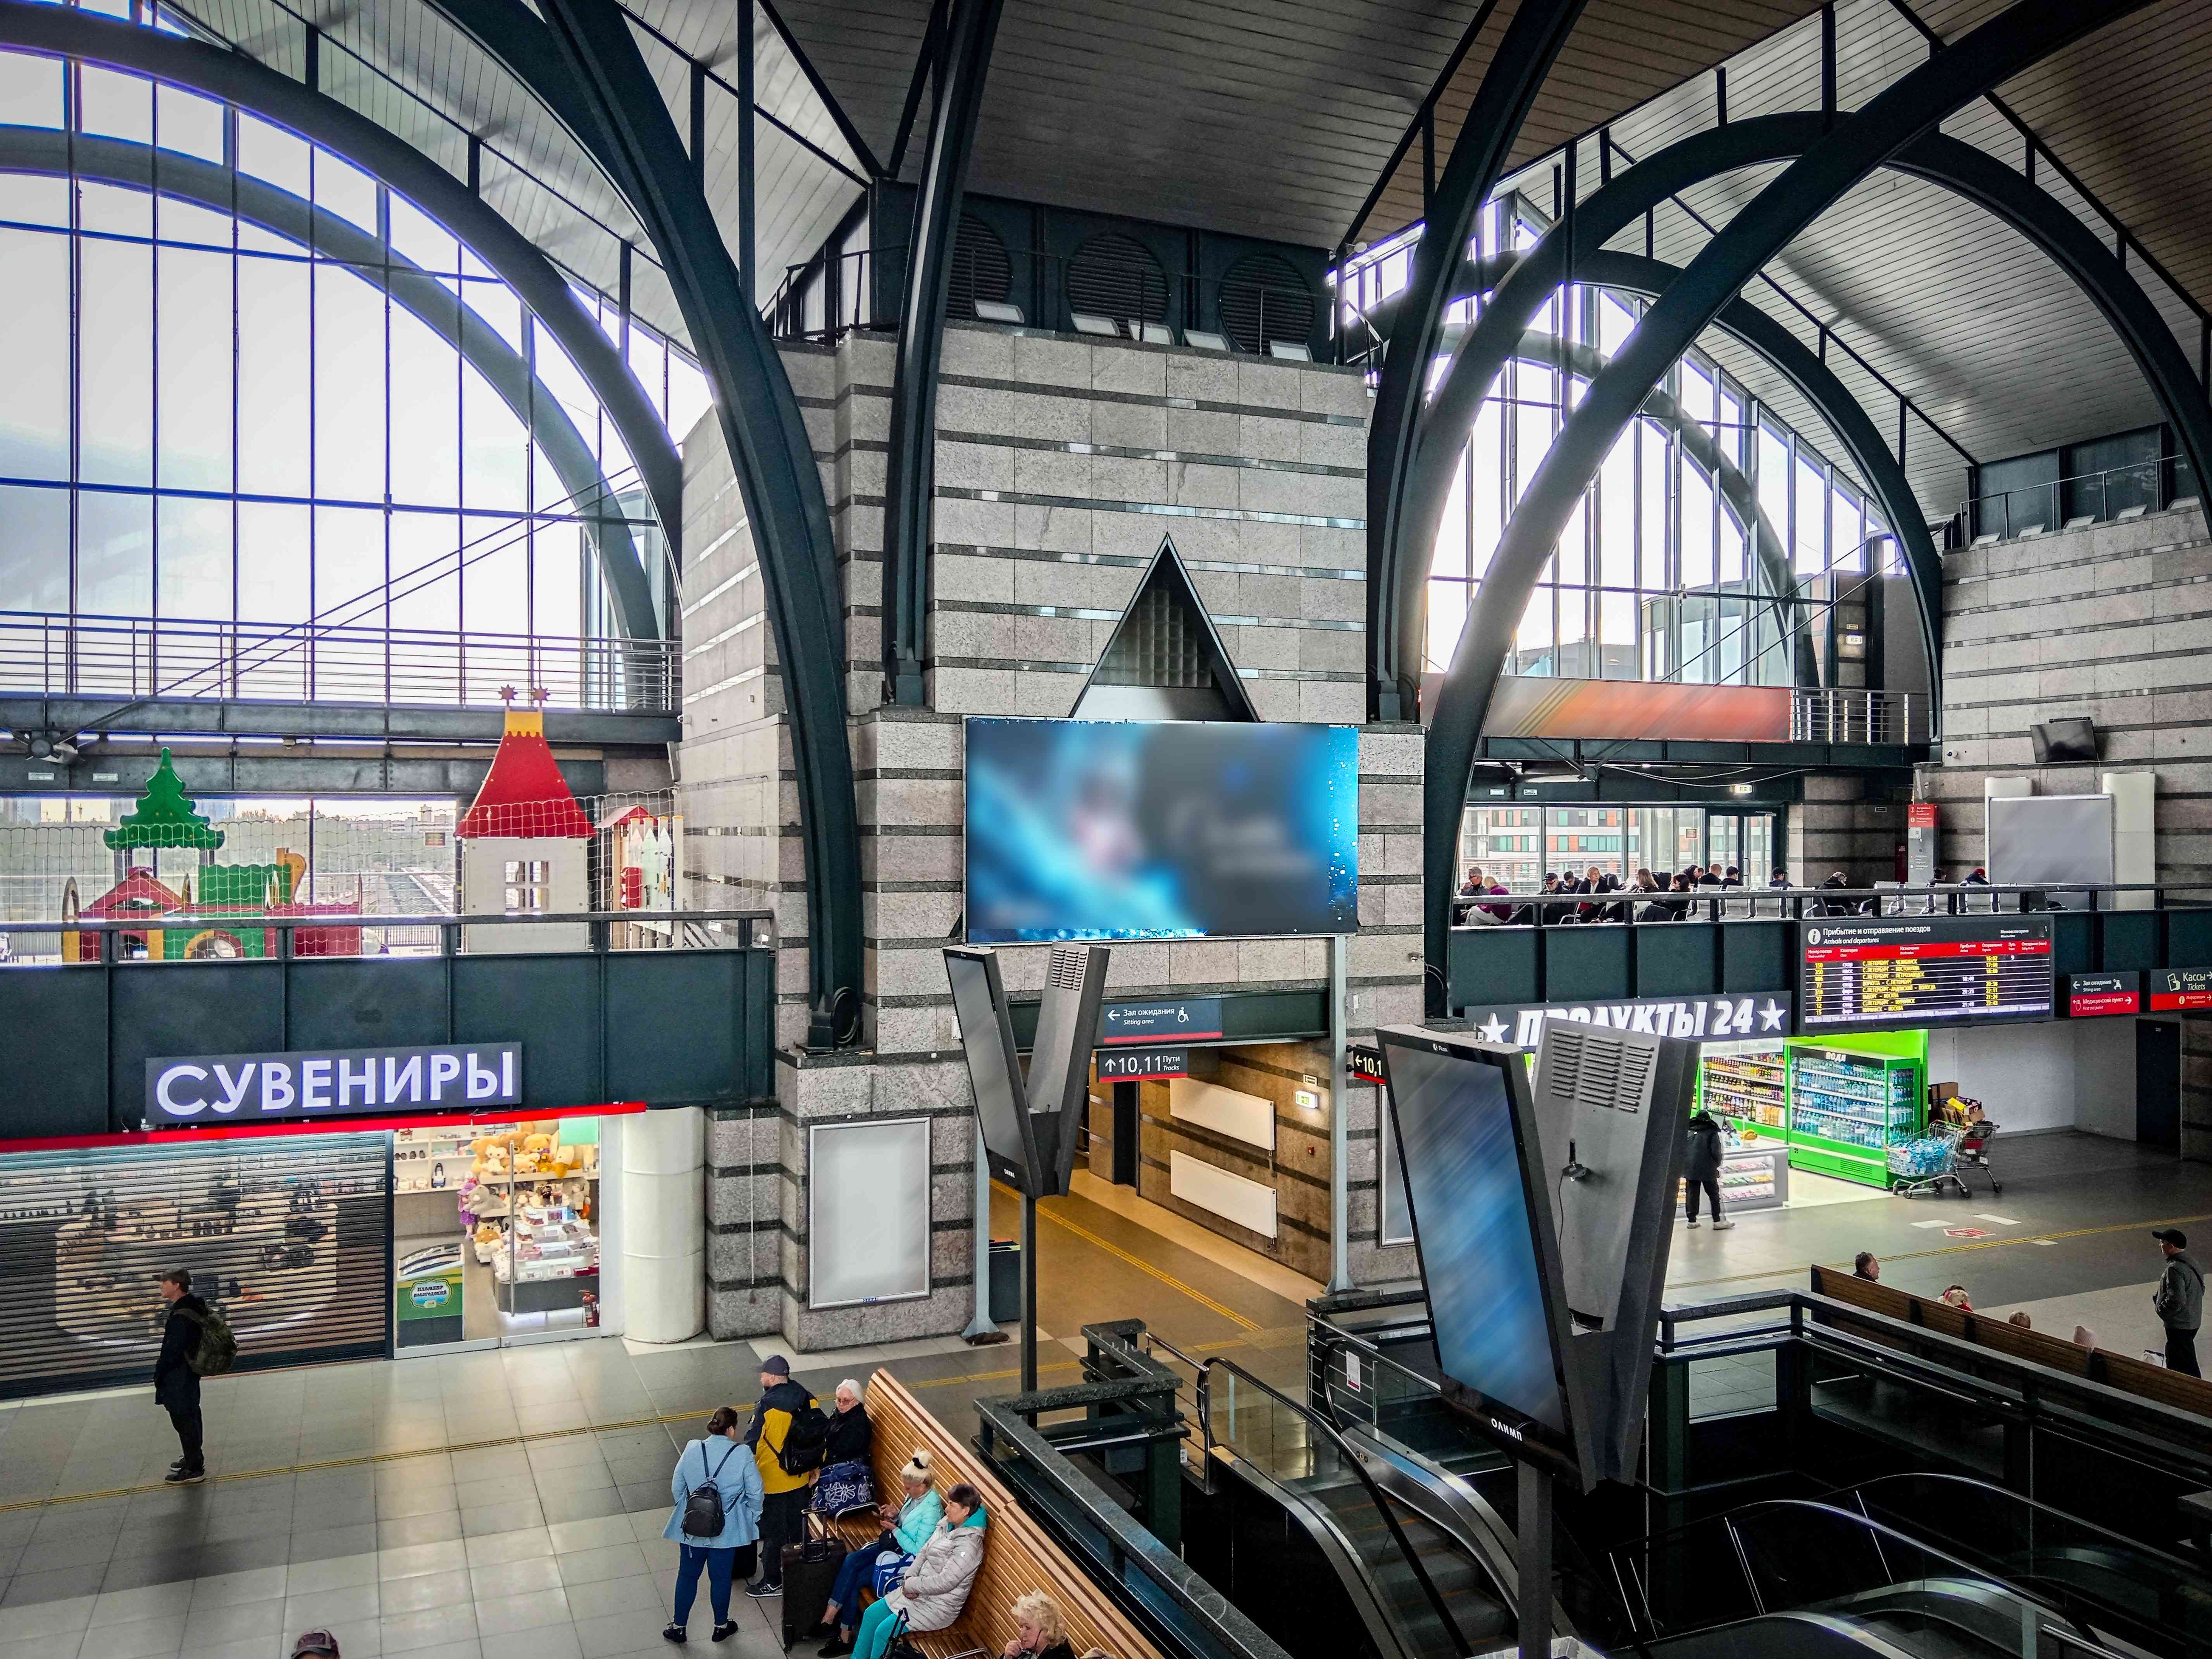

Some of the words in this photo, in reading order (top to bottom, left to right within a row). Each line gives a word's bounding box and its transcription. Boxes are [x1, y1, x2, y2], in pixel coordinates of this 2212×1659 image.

[1823, 927, 1856, 937] Прибытие
[2183, 972, 2206, 982] Кассы
[1711, 998, 1754, 1035] 24
[1118, 1056, 1161, 1075] 10,11
[1163, 1055, 1180, 1064] Пути
[156, 1051, 513, 1116] СУВЕНИРЫ
[1490, 1418, 1522, 1442] ОЛИМП
